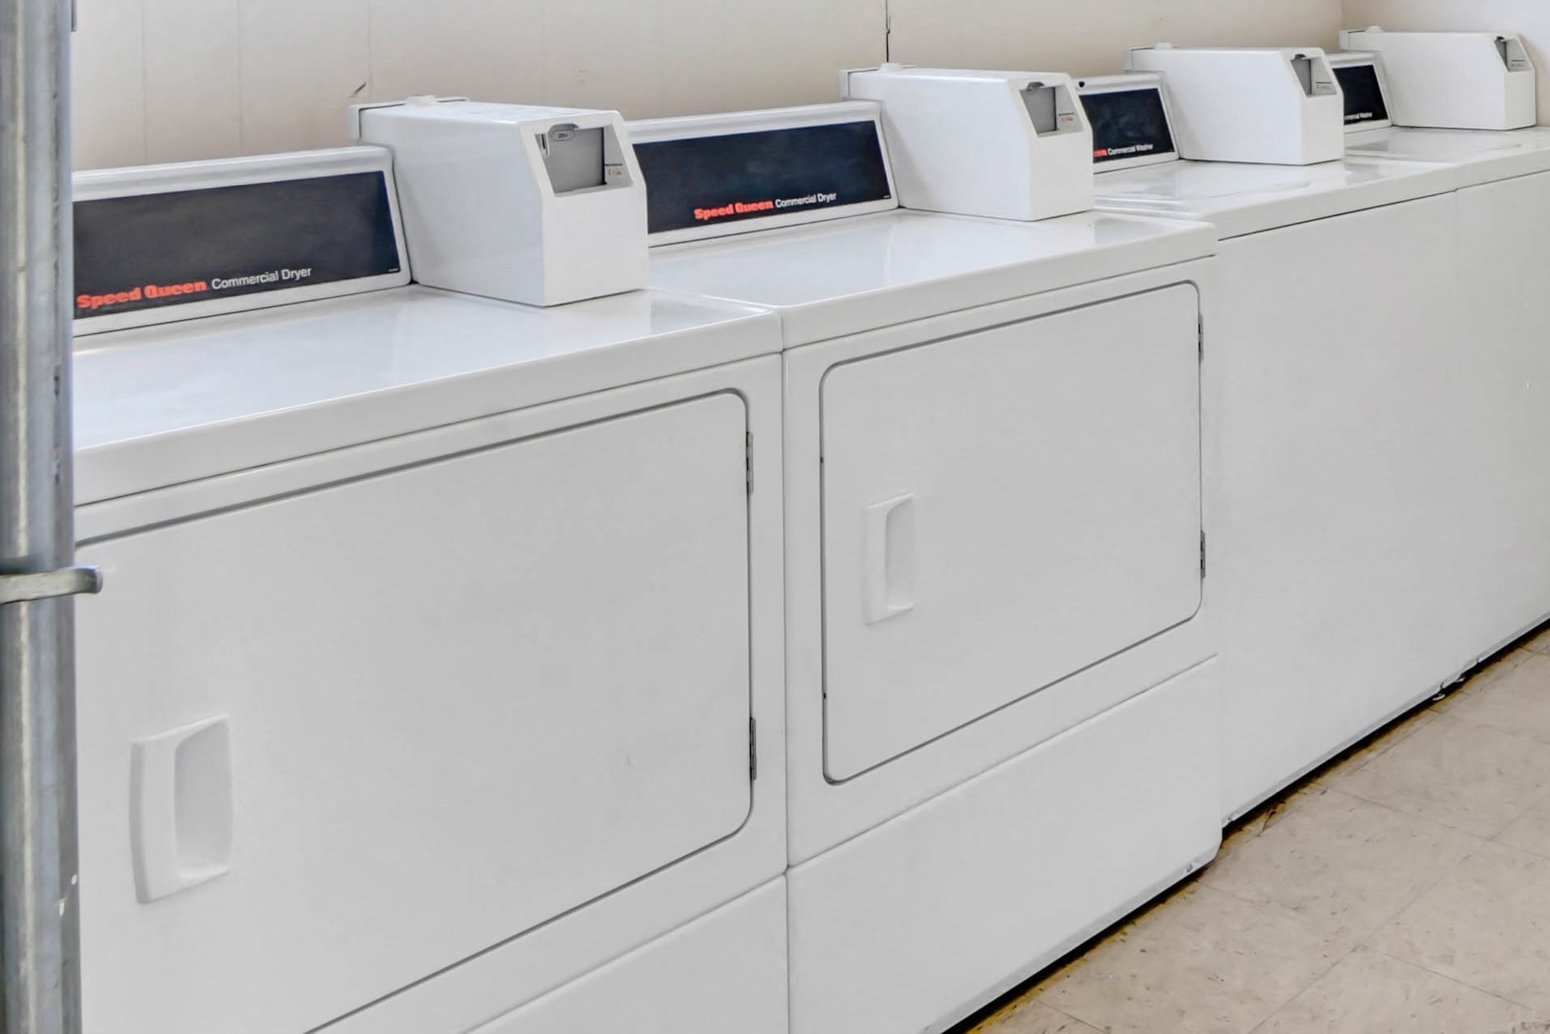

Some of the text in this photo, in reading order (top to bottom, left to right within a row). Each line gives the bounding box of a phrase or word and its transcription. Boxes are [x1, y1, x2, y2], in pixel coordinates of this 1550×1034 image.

[694, 192, 836, 220] Speed Queen Commercial Dryer
[76, 267, 312, 309] Speed Queen Commercial Dryer
